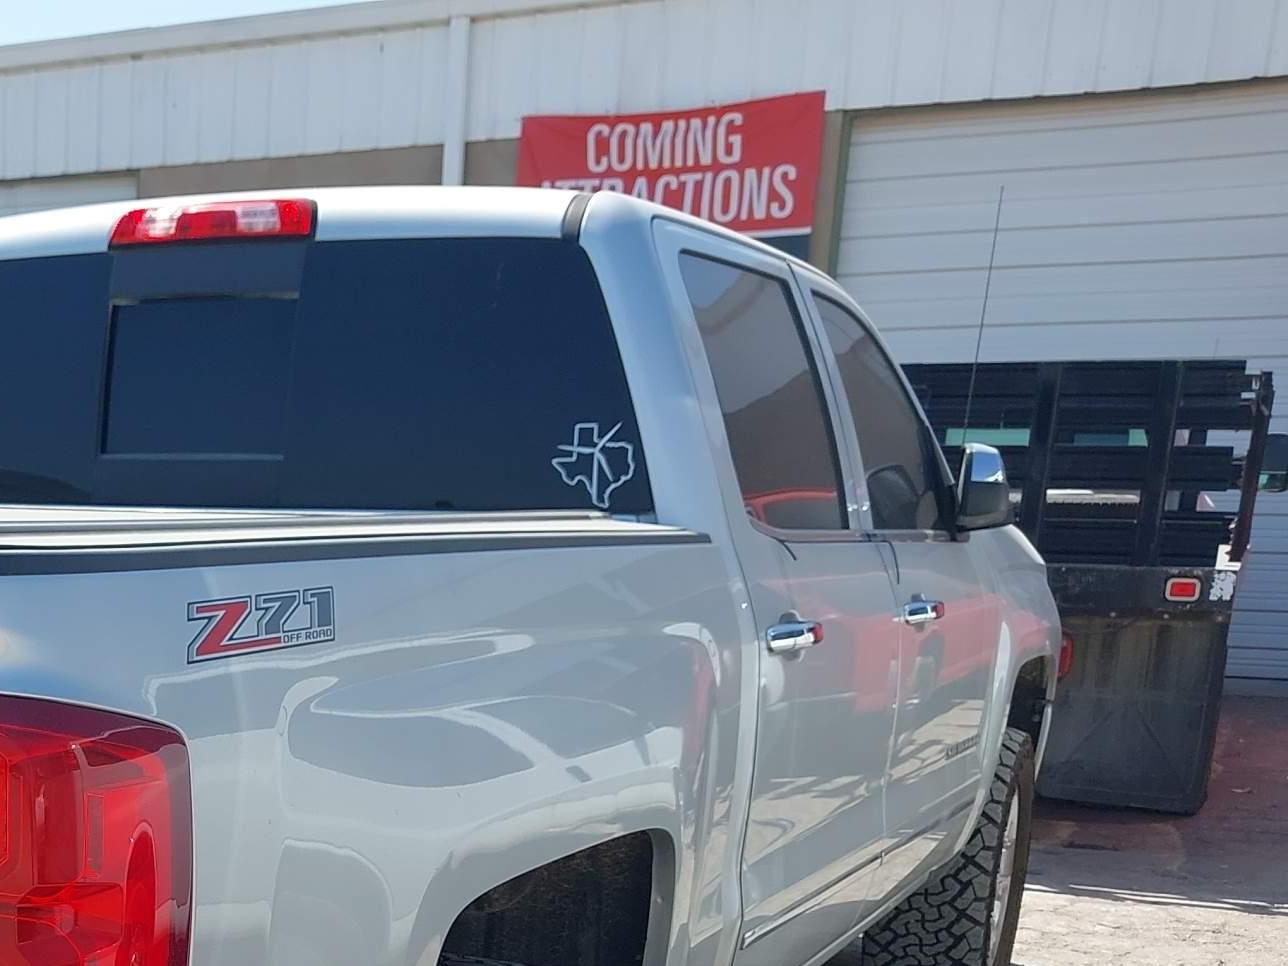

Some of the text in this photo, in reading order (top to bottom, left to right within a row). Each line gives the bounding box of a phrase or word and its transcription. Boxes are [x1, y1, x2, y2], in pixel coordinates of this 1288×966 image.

[586, 112, 743, 173] COMING
[187, 585, 335, 664] Z71
[283, 628, 332, 643] OFF ROAD
